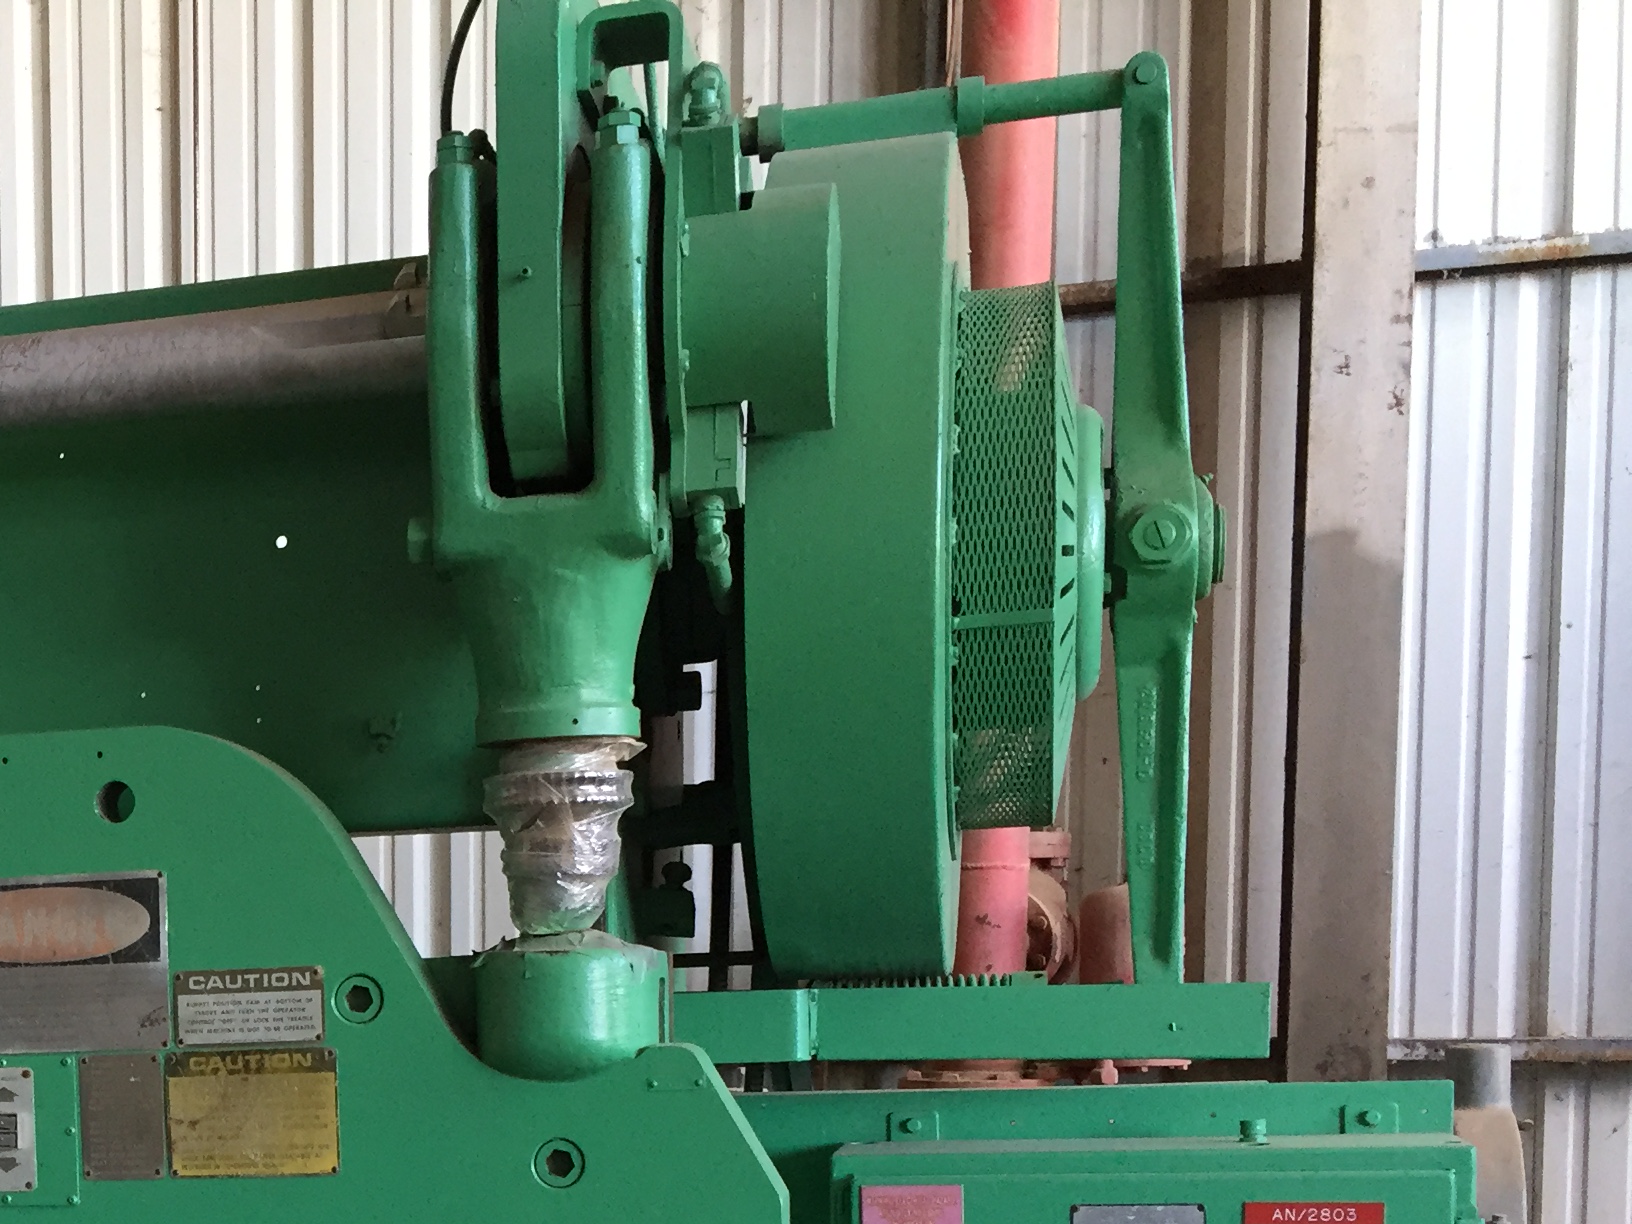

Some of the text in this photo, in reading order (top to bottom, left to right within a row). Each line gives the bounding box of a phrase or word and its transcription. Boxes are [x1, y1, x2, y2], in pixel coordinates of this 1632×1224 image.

[188, 972, 311, 990] CAUTION
[189, 1052, 312, 1071] CAUTION
[1271, 1207, 1358, 1223] AN/2803
